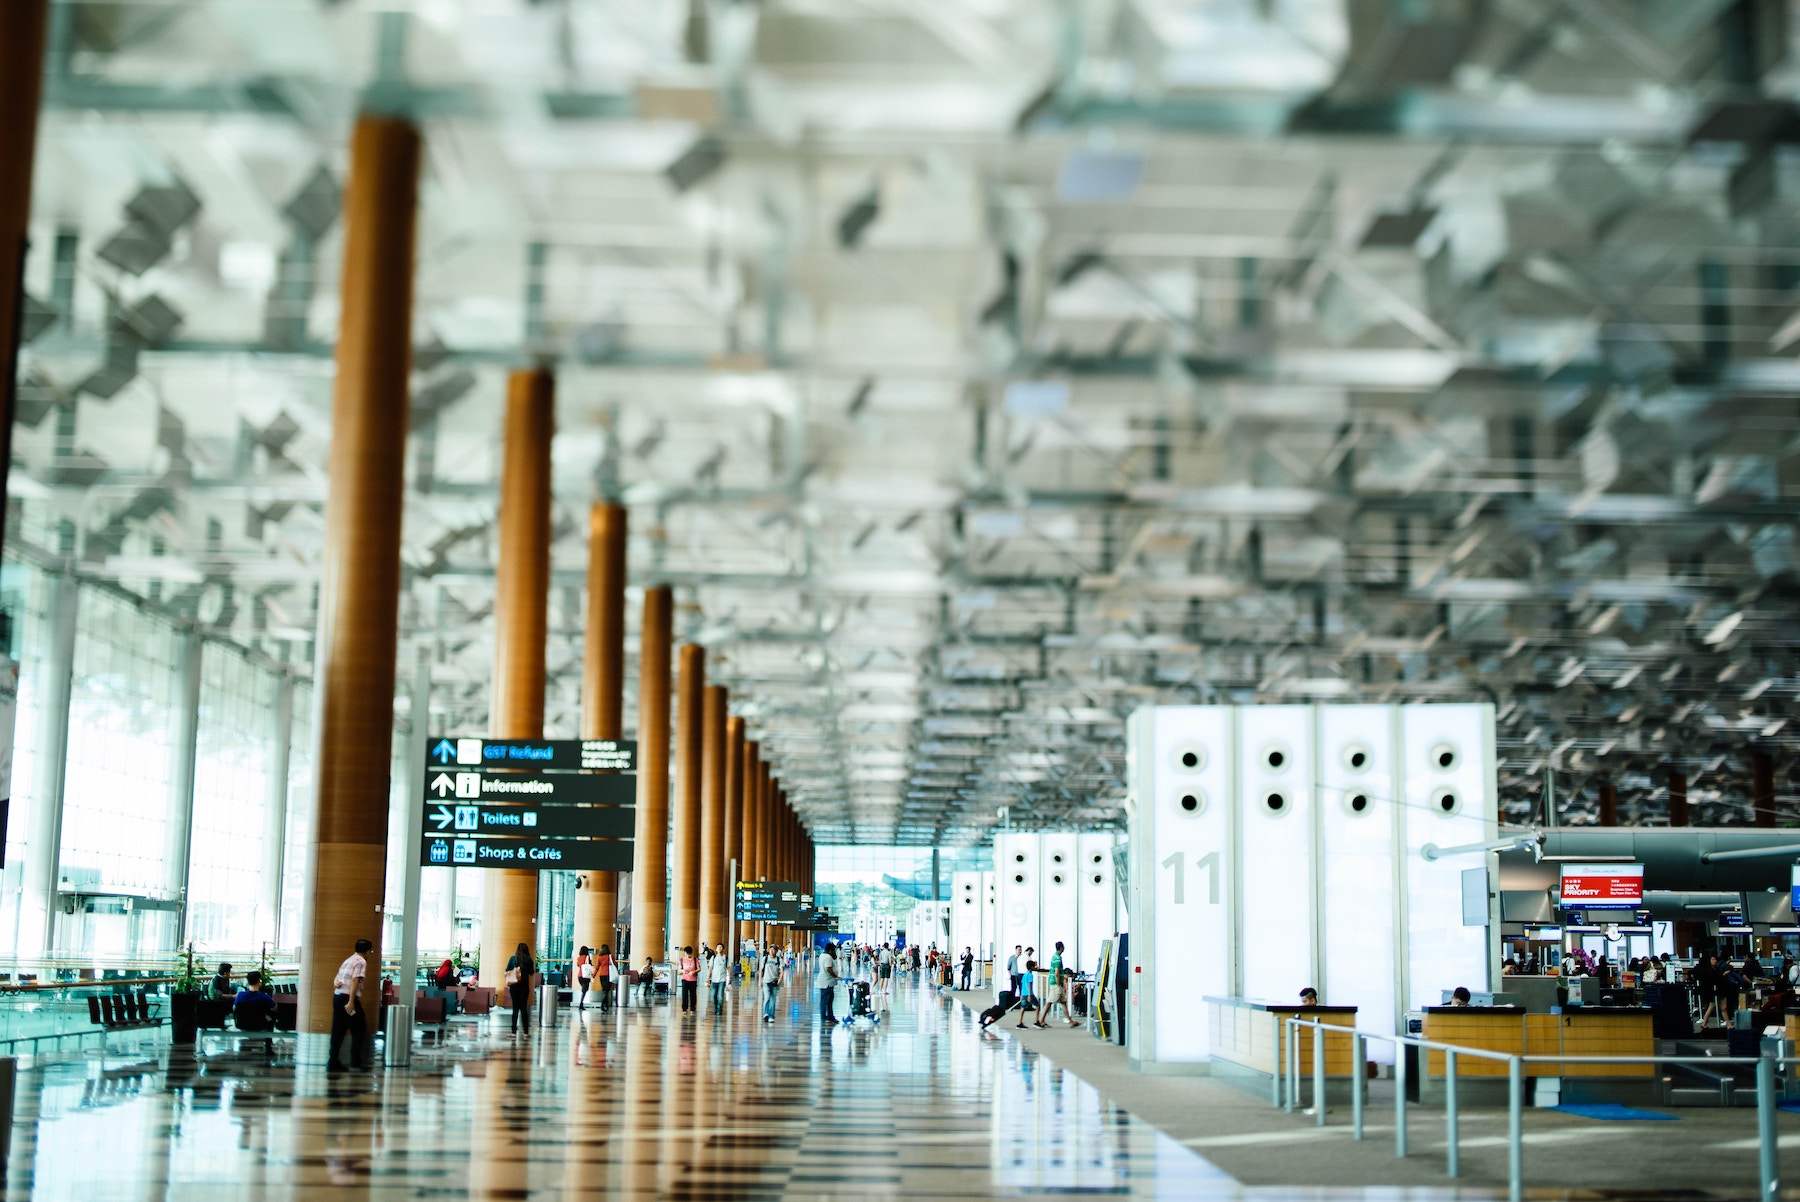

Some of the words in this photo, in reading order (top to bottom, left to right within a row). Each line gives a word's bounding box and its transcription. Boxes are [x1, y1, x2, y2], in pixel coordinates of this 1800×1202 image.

[483, 745, 507, 759] GST
[509, 745, 554, 760] Refund
[482, 779, 554, 794] Information
[482, 812, 520, 826] Toilets
[479, 846, 514, 861] Shops
[517, 848, 527, 860] &
[529, 847, 562, 861] Cafés
[1161, 852, 1220, 904] 11
[1658, 923, 1667, 938] 7
[1565, 1017, 1571, 1027] 1
